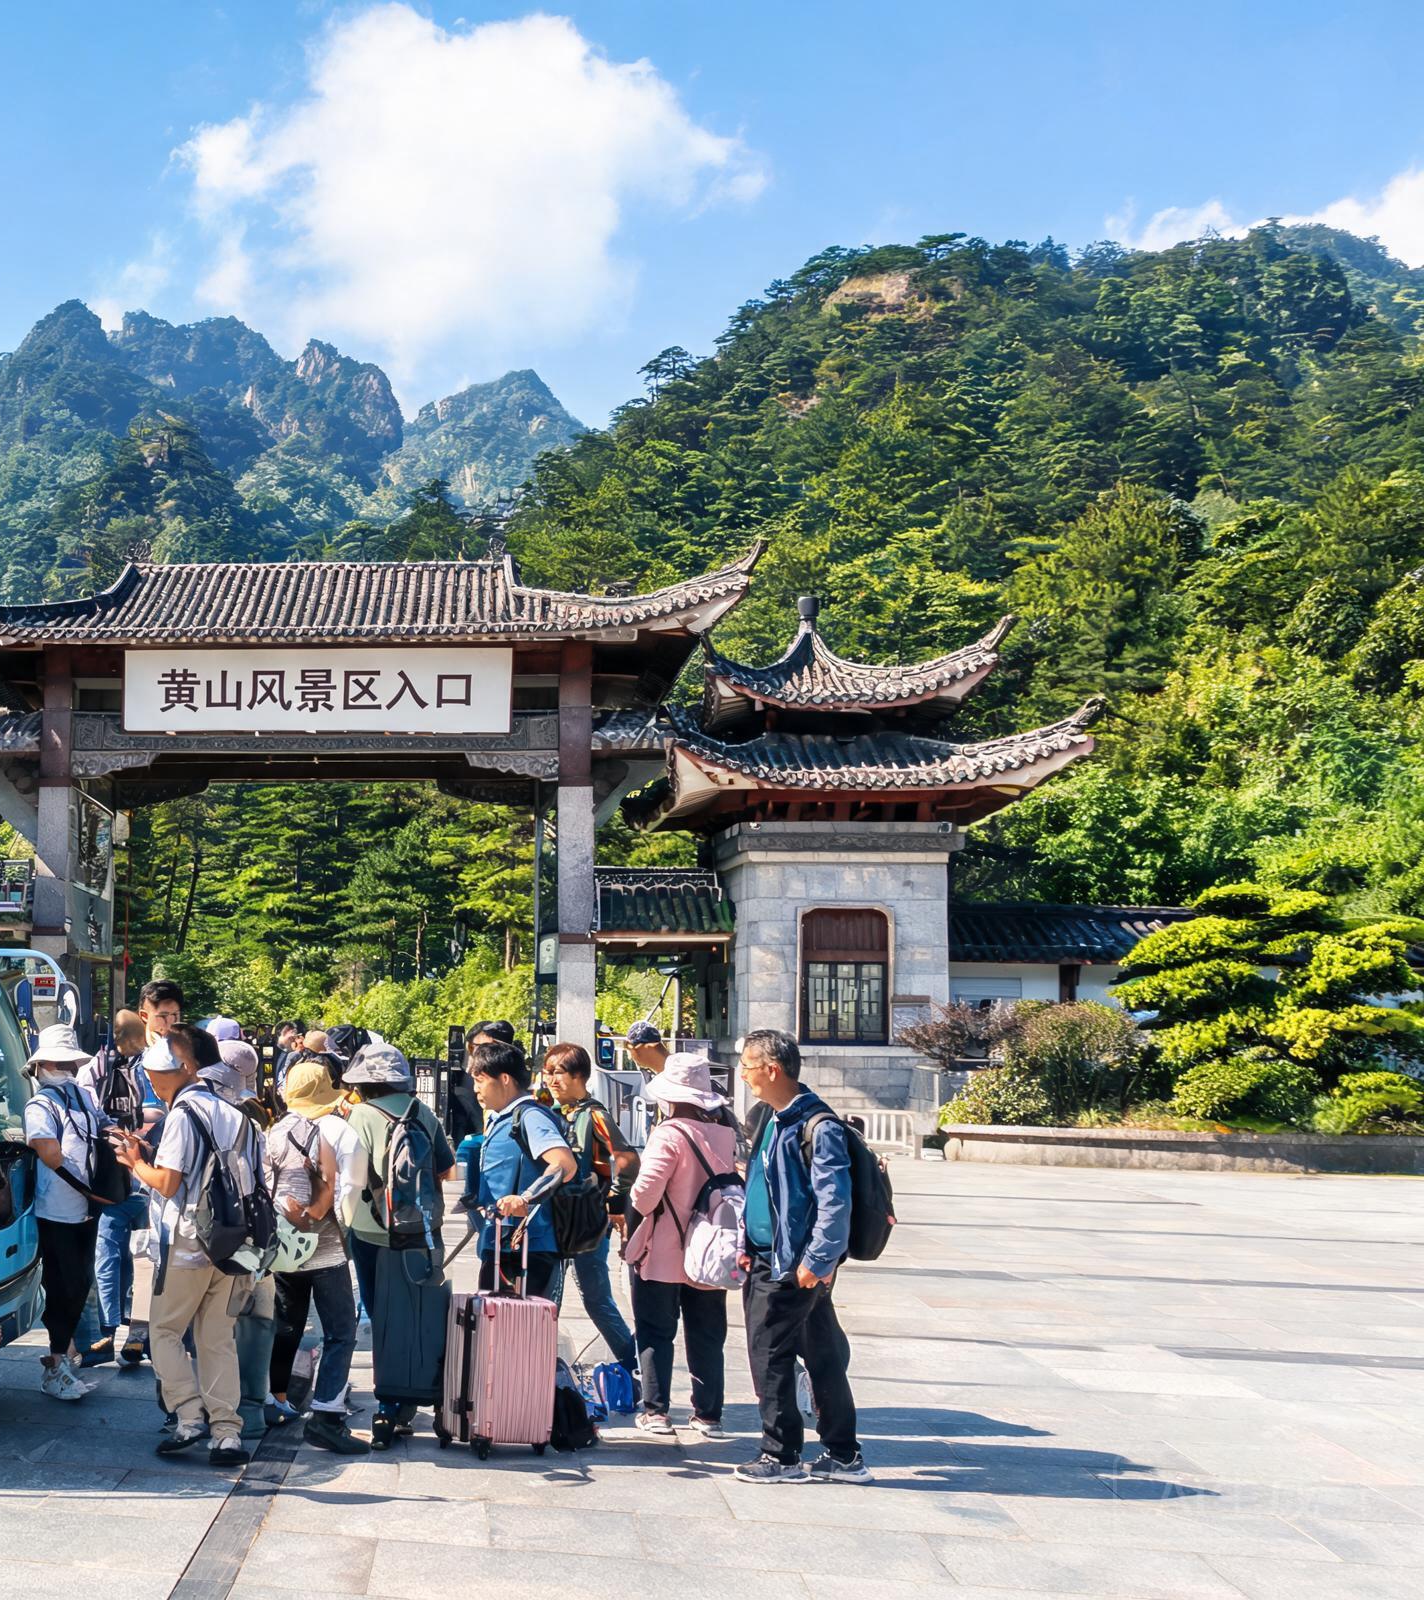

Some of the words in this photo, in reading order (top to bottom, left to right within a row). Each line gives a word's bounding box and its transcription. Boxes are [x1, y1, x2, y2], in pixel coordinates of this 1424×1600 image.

[157, 668, 472, 713] 黄山风景区入口
